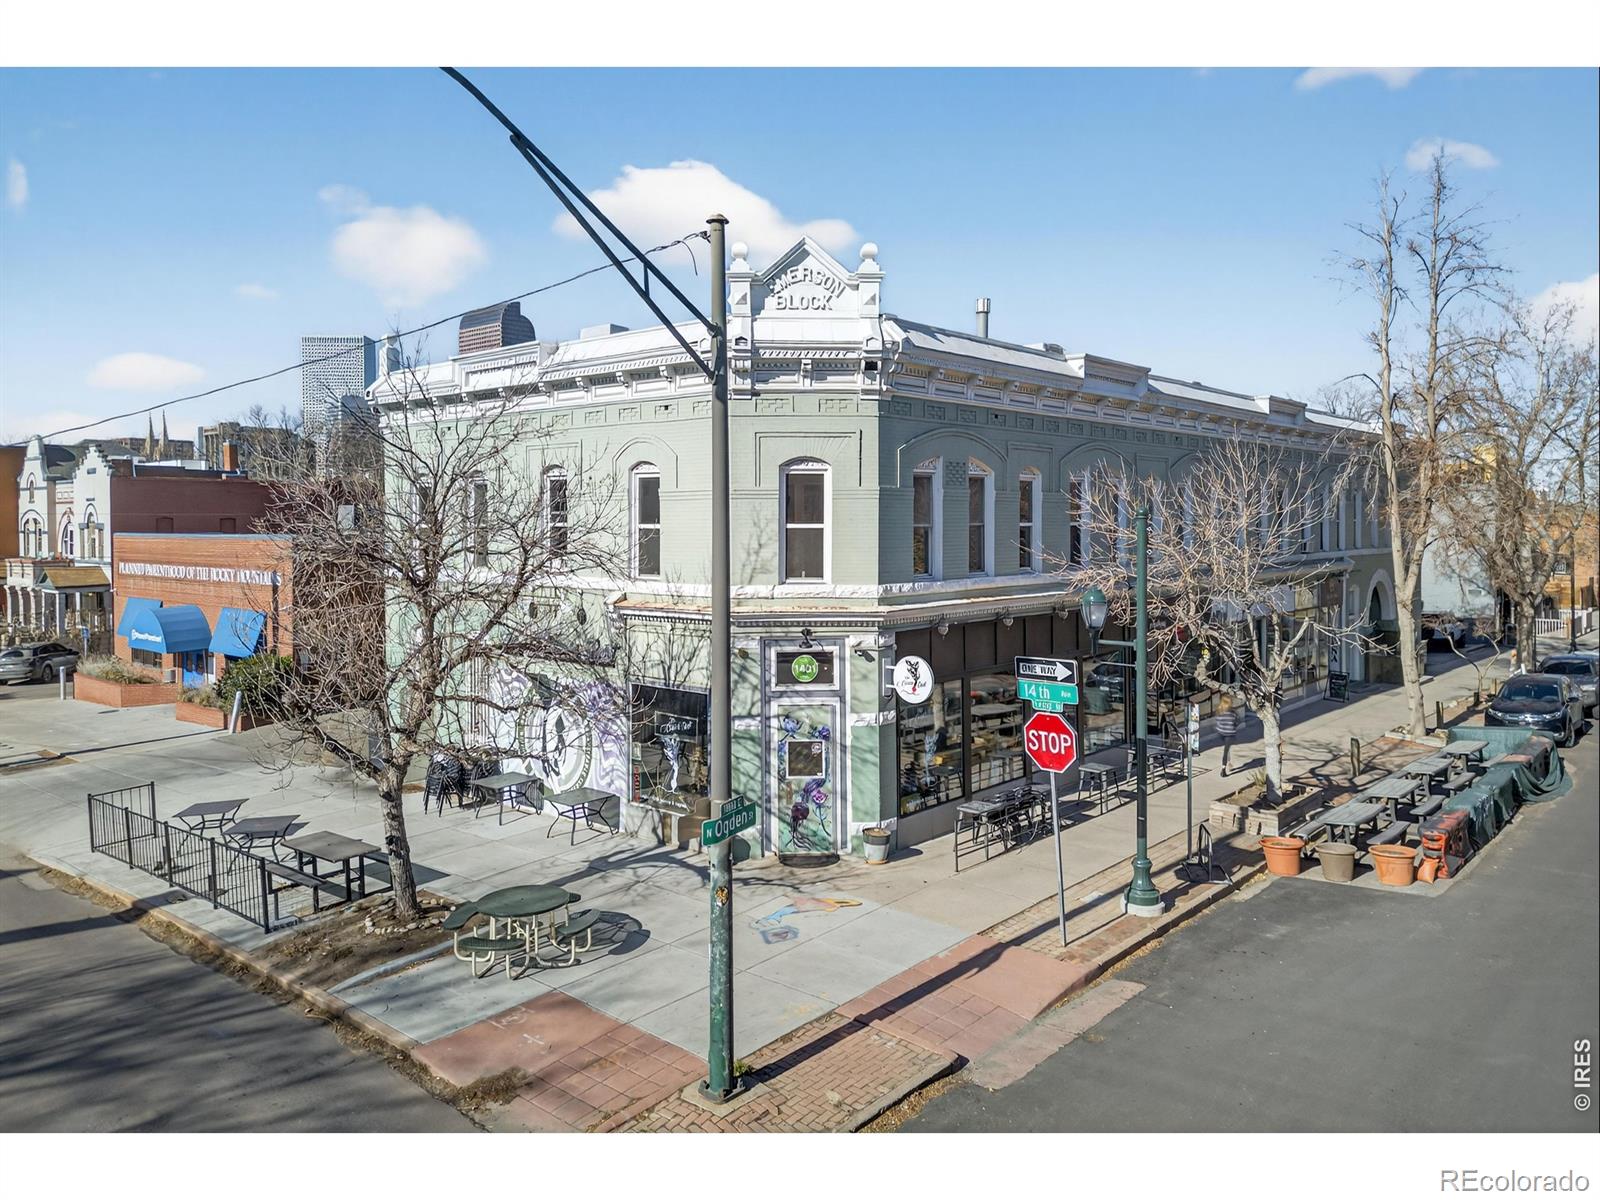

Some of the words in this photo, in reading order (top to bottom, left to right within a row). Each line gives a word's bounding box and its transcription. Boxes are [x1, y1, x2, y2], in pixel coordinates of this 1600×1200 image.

[776, 295, 833, 310] BLOCK
[186, 567, 195, 579] OF
[236, 569, 281, 586] MOUNTAIS
[1021, 664, 1038, 674] ONE
[1040, 665, 1057, 676] WAY
[1028, 729, 1072, 755] STOP
[706, 828, 712, 838] N
[715, 812, 748, 838] Ogden
